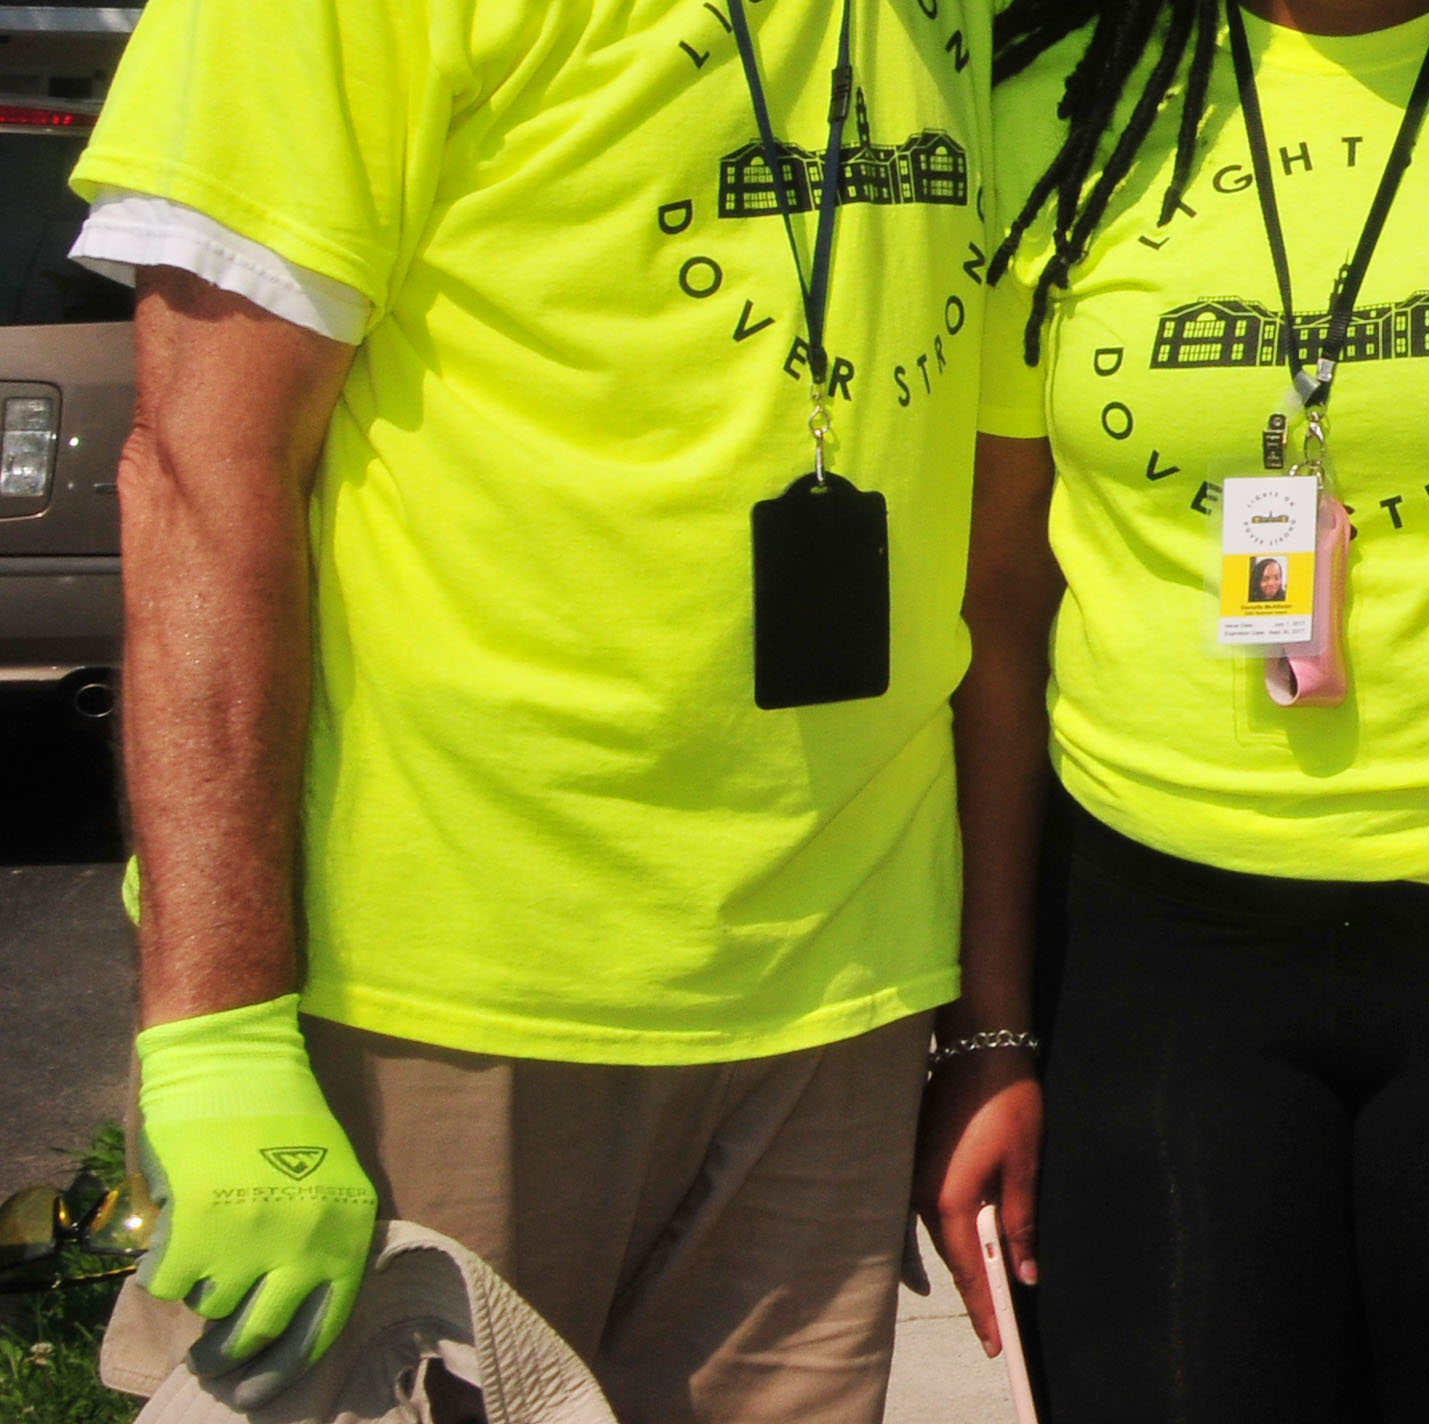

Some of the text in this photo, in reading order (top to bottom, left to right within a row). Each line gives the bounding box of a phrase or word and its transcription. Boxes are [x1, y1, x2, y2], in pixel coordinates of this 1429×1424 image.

[1137, 136, 1370, 251] LIGHT
[657, 198, 855, 402] DOVER
[1093, 346, 1224, 516] DOVE
